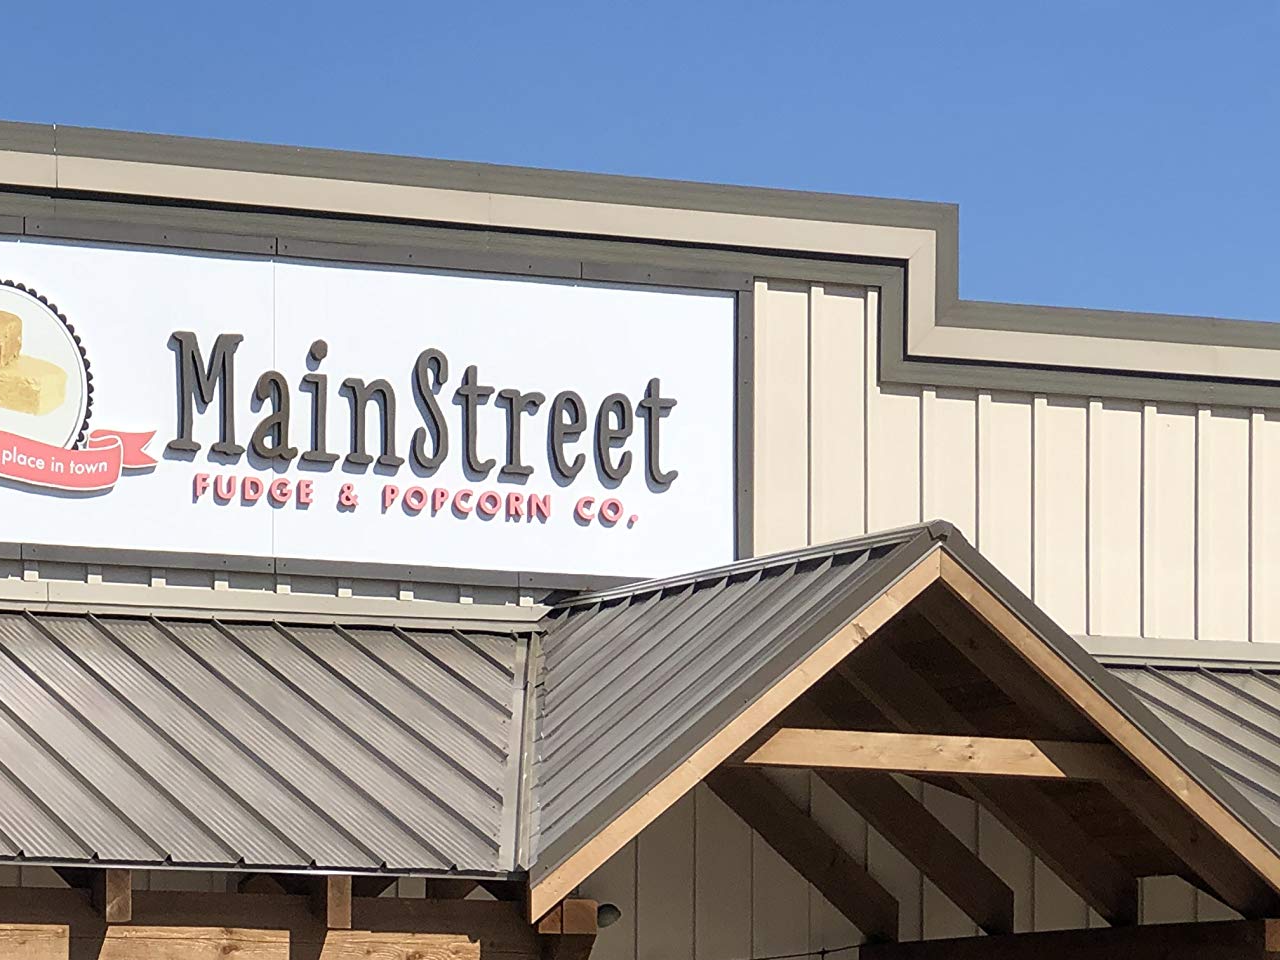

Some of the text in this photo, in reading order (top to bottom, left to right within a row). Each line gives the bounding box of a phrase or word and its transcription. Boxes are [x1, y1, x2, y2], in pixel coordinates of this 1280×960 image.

[167, 330, 679, 488] MainStreet
[1, 446, 46, 470] place
[50, 456, 65, 473] in
[69, 459, 109, 475] town
[194, 472, 640, 527] FUDGE & POPCORN CO.
